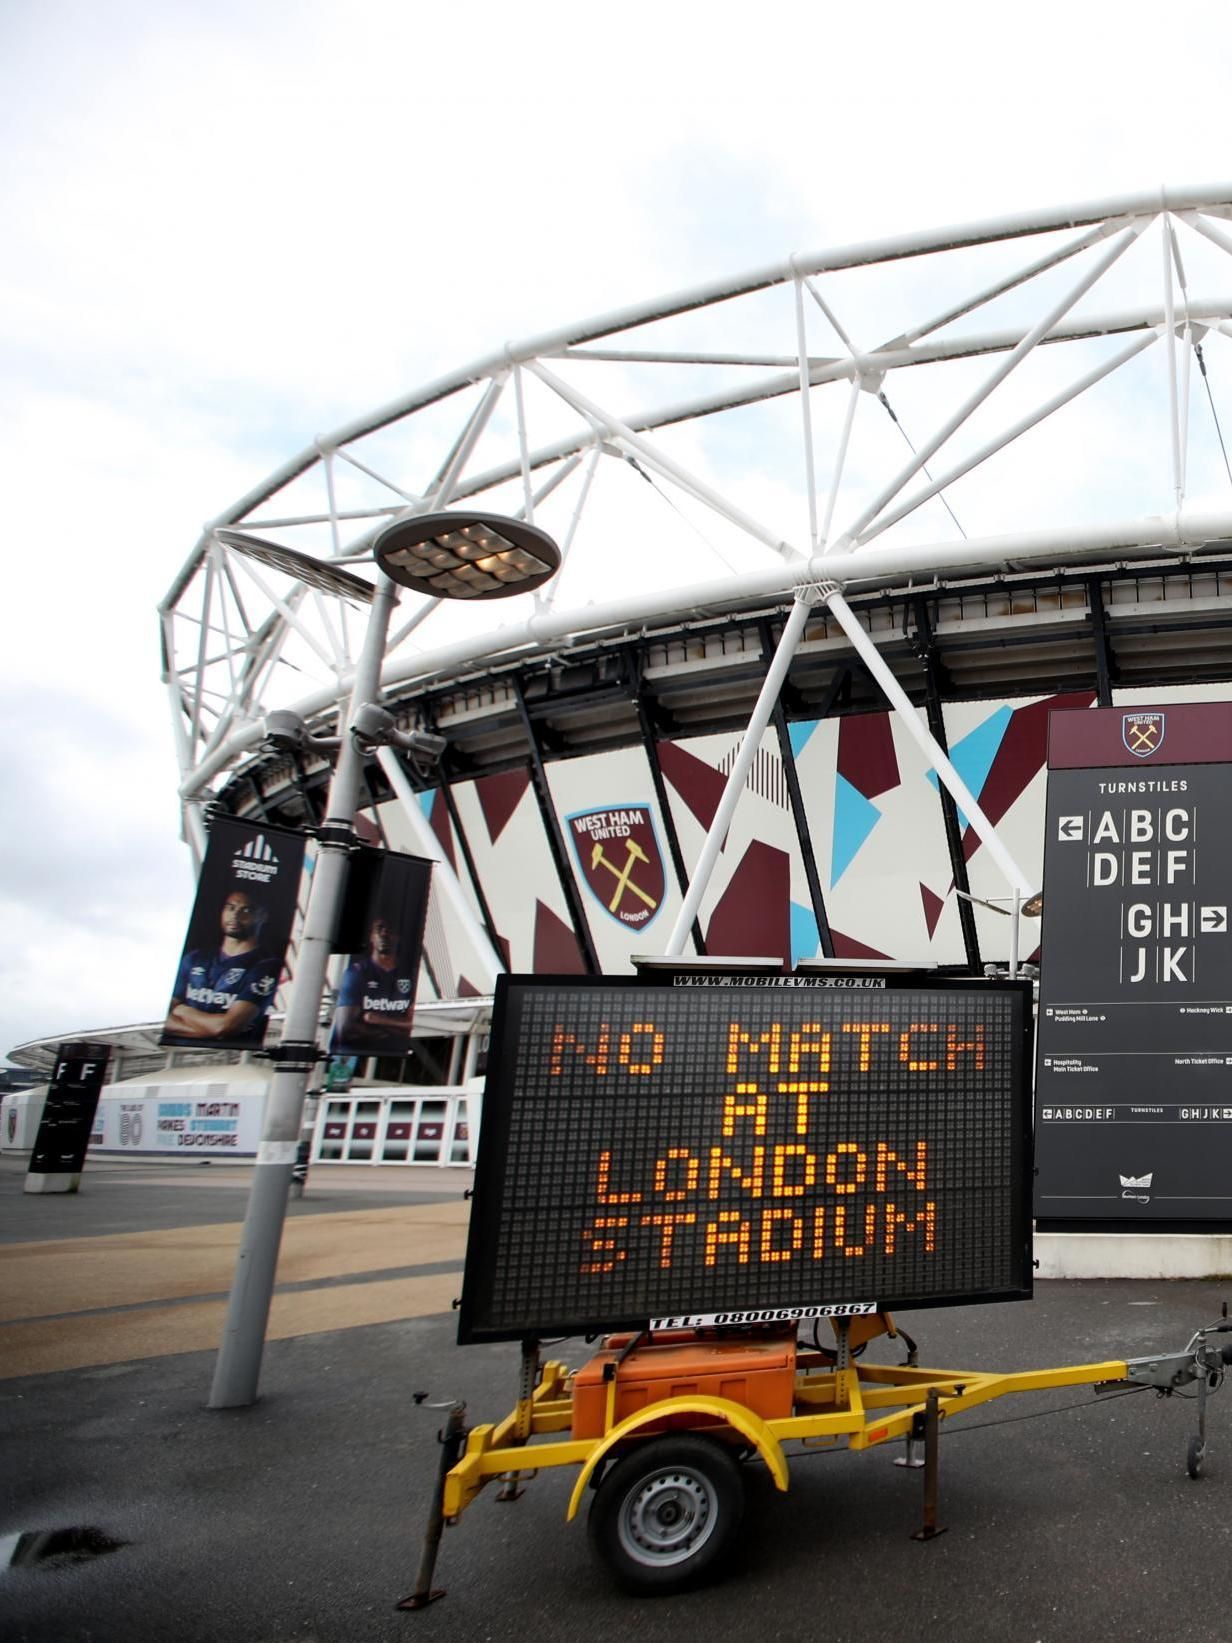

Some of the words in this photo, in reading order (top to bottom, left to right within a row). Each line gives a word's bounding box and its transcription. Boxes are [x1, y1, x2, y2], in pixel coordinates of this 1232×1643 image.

[1099, 780, 1188, 794] TURNSTILES
[574, 813, 607, 833] WEST
[608, 810, 644, 826] HAM
[1093, 811, 1120, 844] A
[1130, 809, 1154, 842] B
[1165, 808, 1189, 841] C
[591, 826, 631, 840] UNITED
[232, 859, 278, 875] STADIUM
[235, 869, 272, 883] STORE
[1093, 852, 1118, 886] D
[1131, 851, 1152, 885] E
[1167, 850, 1188, 884] F
[620, 909, 649, 922] LONDON
[1127, 904, 1152, 938] G
[1163, 903, 1189, 937] H
[1130, 947, 1146, 982] J
[1163, 947, 1188, 982] K
[674, 976, 884, 988] WWW.MOBILEVMS.CO.UK
[363, 995, 410, 1013] betway
[549, 1022, 665, 1076] NO
[726, 1022, 986, 1075] MATCH
[80, 1063, 96, 1080] F
[722, 1082, 829, 1136] AT
[1055, 1109, 1063, 1119] A
[1065, 1109, 1073, 1119] B
[1075, 1109, 1083, 1119] C
[1085, 1109, 1093, 1119] D
[1096, 1109, 1102, 1119] E
[1106, 1109, 1112, 1119] F
[1181, 1109, 1189, 1119] G
[1192, 1109, 1199, 1119] H
[1203, 1109, 1208, 1119] J
[1212, 1109, 1220, 1119] K
[598, 1141, 927, 1204] LONDON
[579, 1201, 935, 1273] STADIUM
[652, 1317, 703, 1330] TEL:
[713, 1303, 875, 1325] 08006906867
